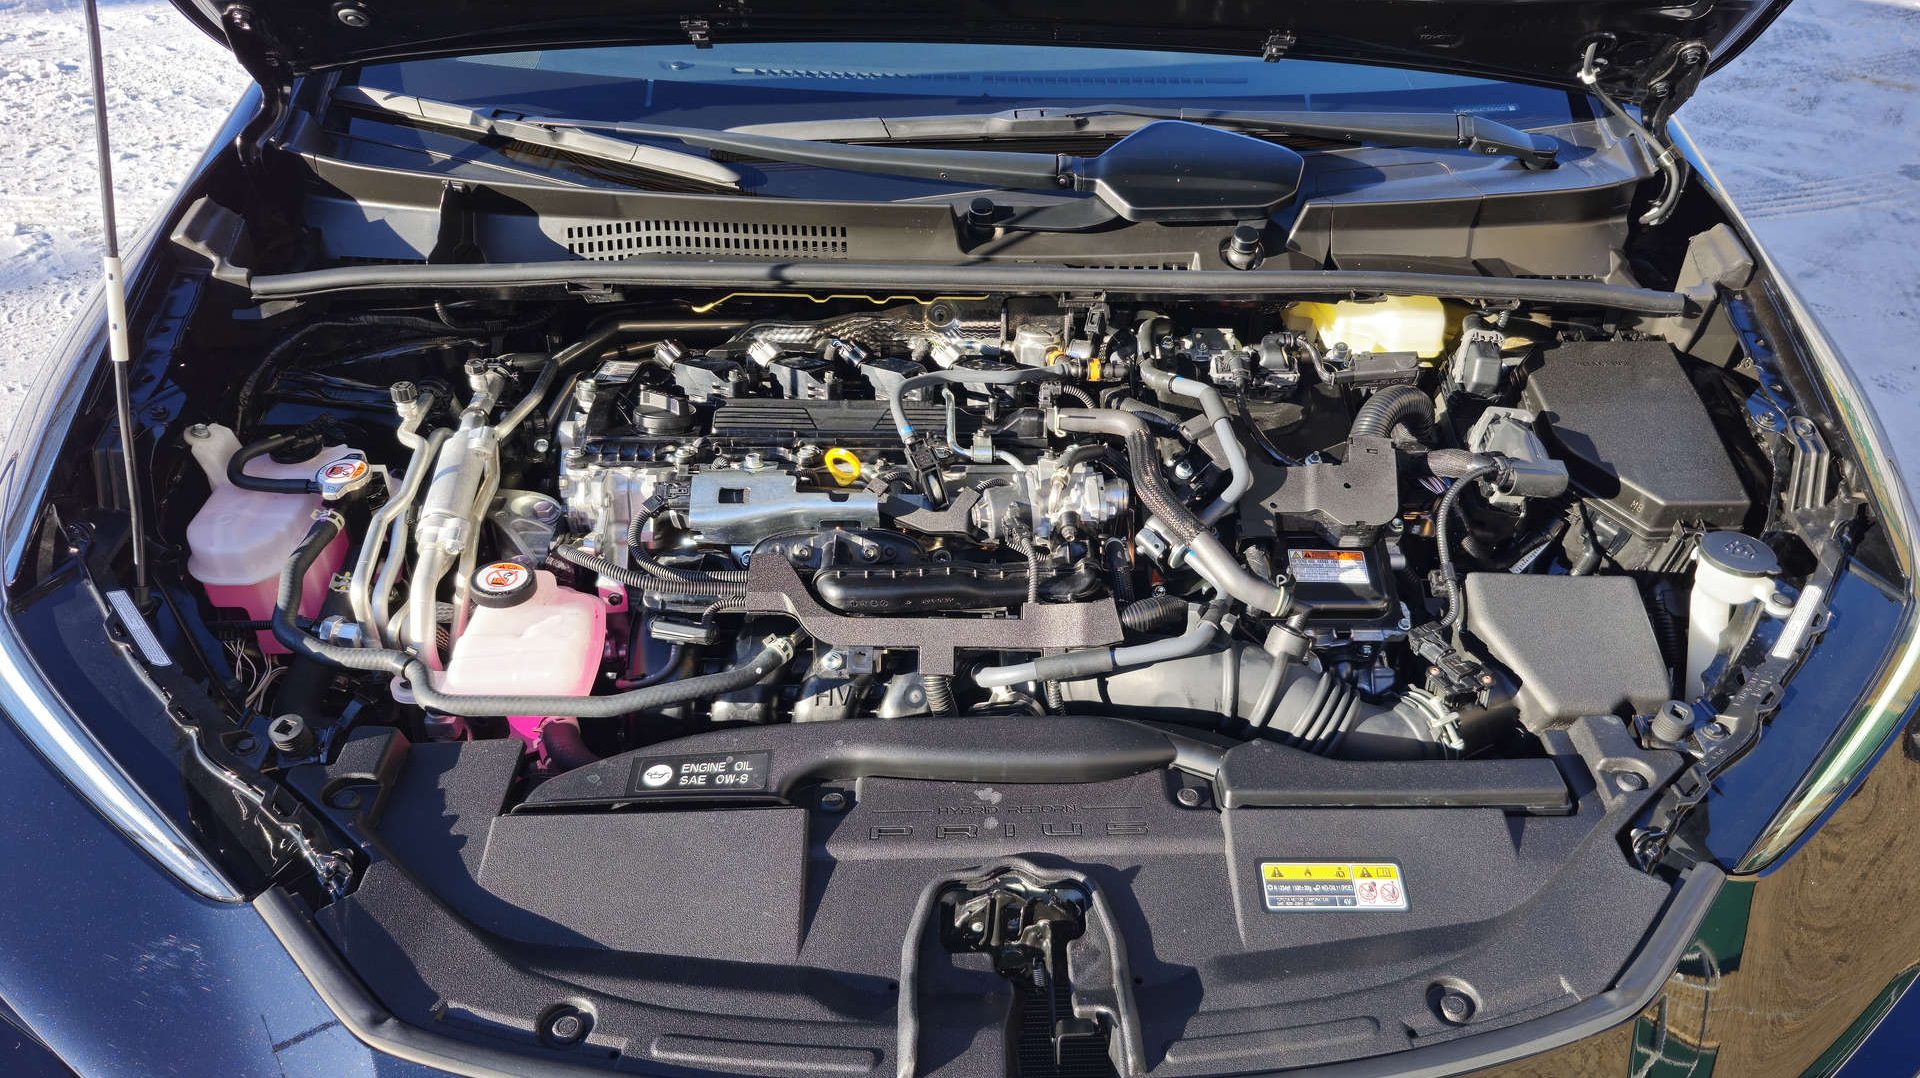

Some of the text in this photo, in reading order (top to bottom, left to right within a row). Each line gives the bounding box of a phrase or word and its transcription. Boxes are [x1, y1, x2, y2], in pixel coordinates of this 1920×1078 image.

[815, 685, 853, 706] HV
[680, 761, 753, 773] ENGINE OIL
[679, 773, 749, 785] SAE 0W-8
[937, 804, 1078, 815] HYBRID REBORN
[869, 821, 1150, 840] PRIUS
